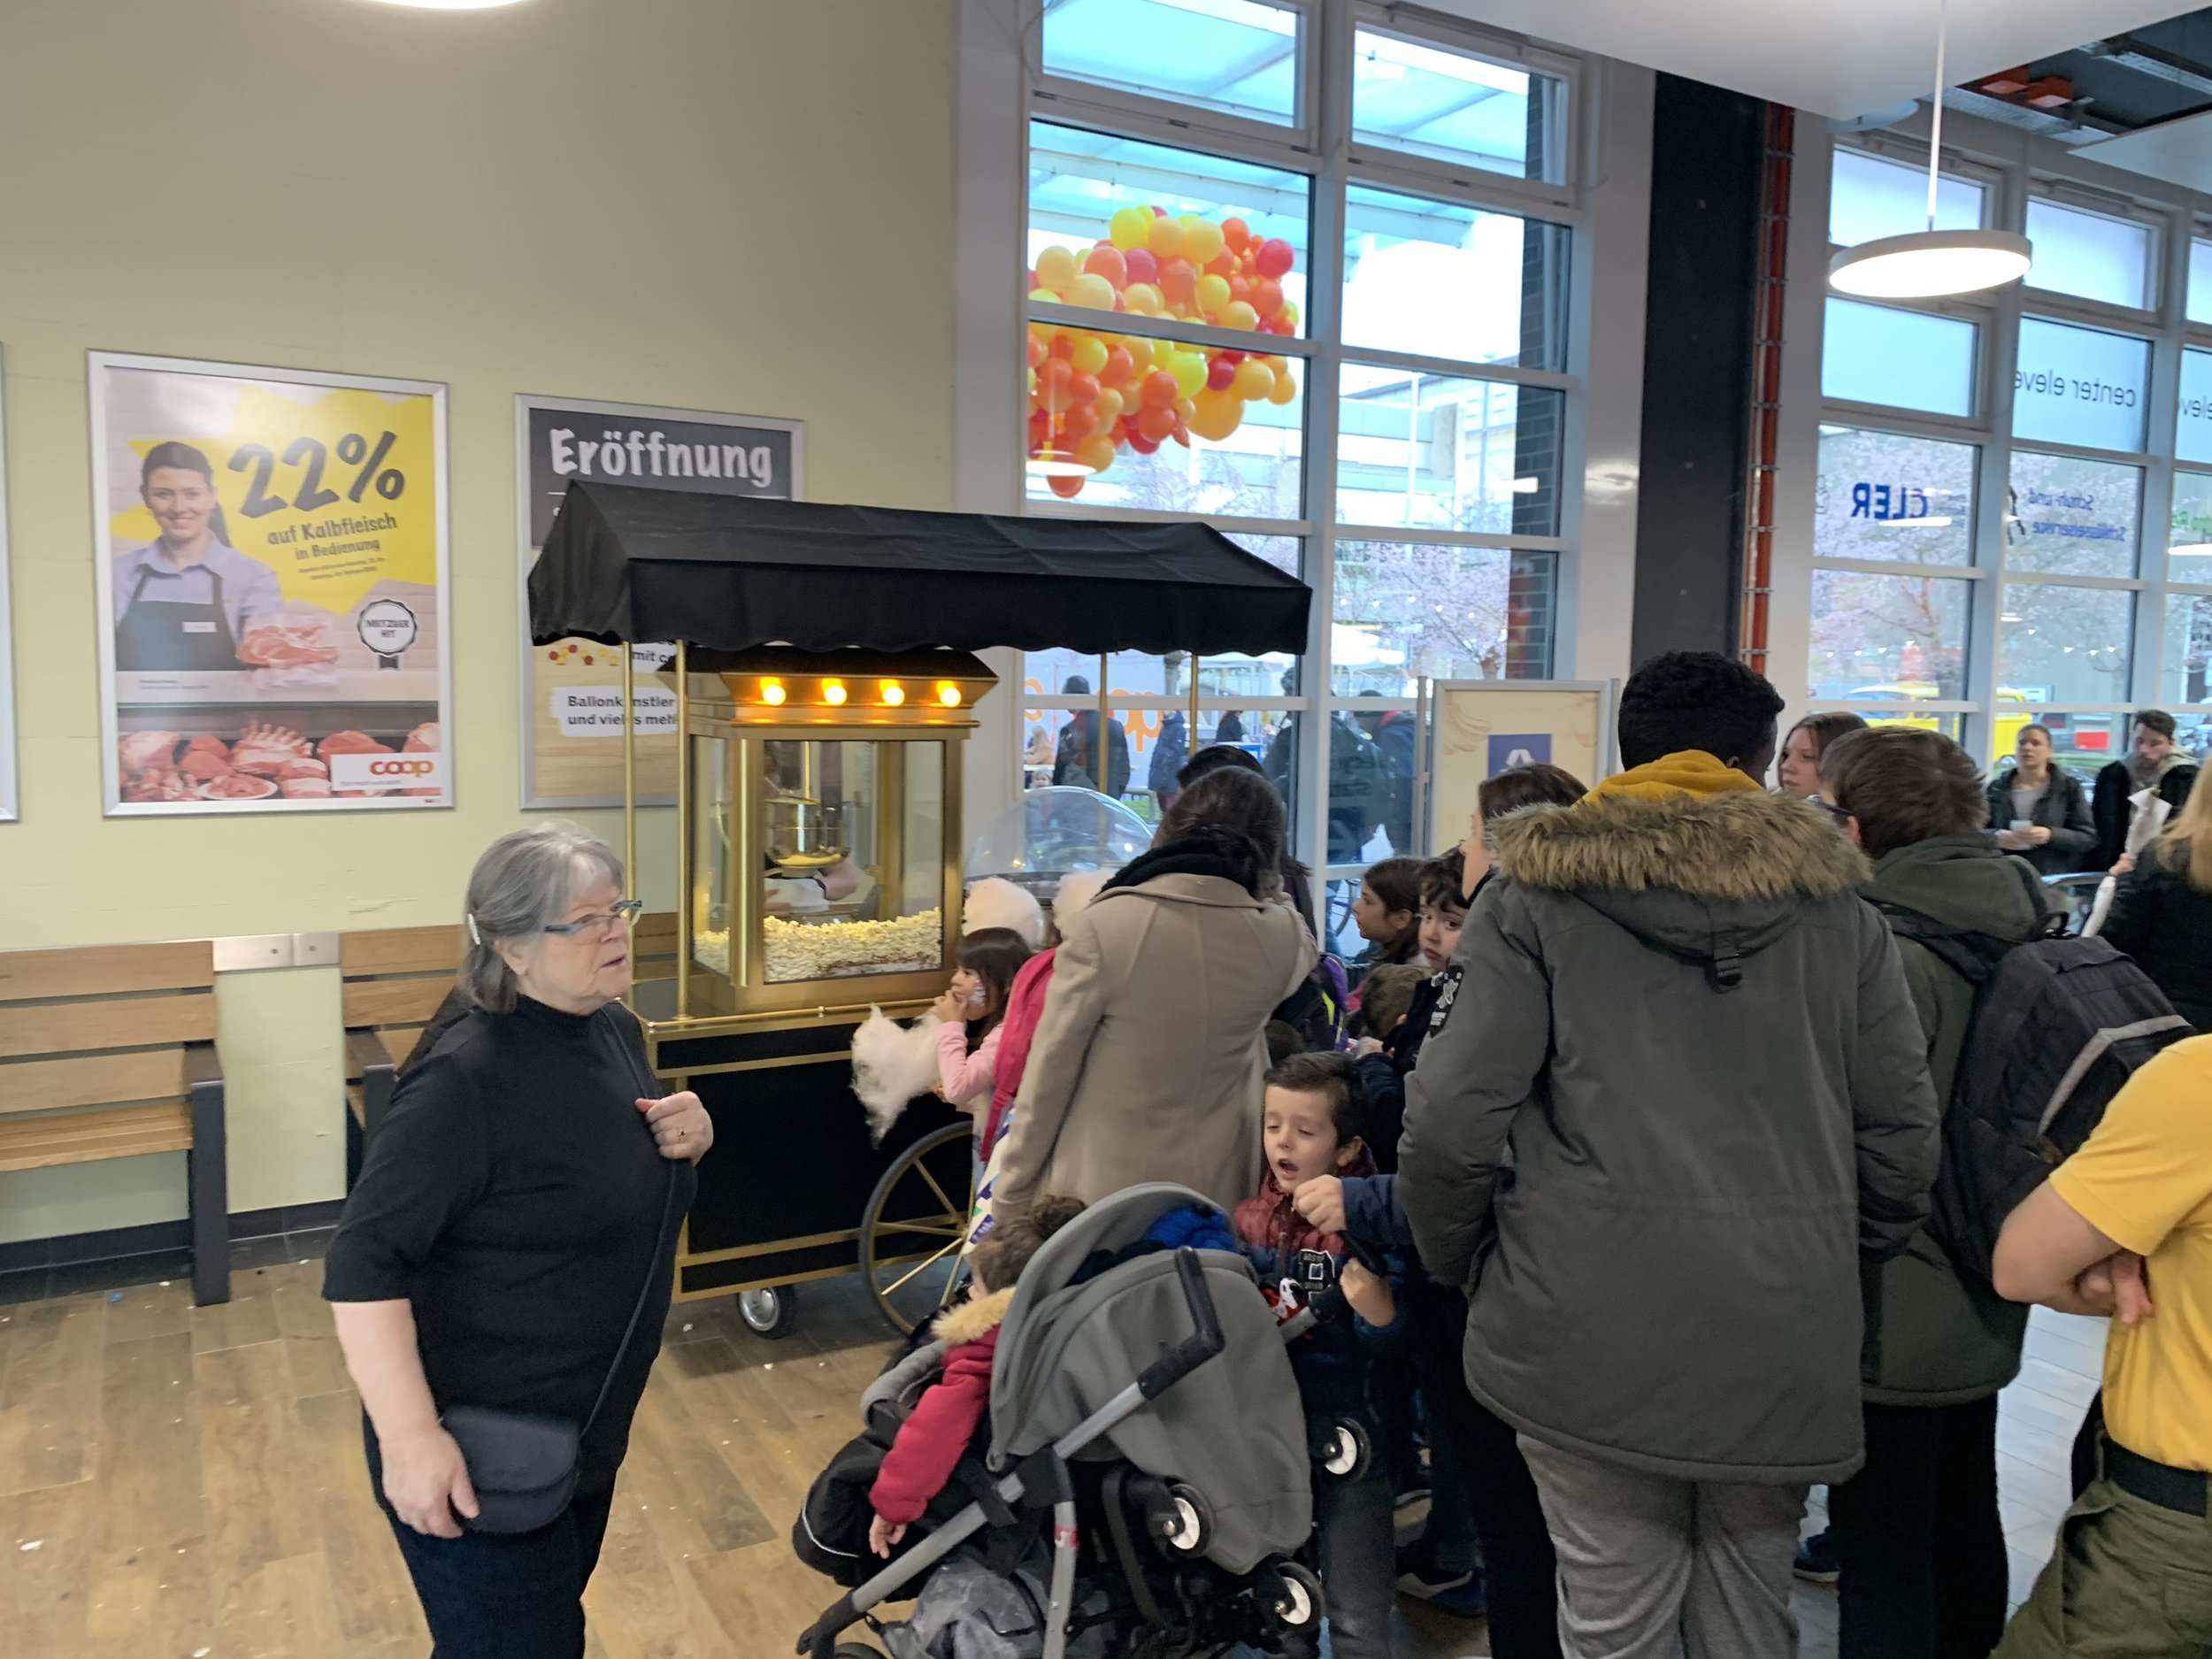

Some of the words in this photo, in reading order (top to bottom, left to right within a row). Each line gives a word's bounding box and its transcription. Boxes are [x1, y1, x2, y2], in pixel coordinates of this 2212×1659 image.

[549, 428, 772, 488] Eröffnung
[227, 430, 405, 518] 22%
[267, 524, 298, 545] auf
[301, 512, 397, 541] Kalbfleisch
[295, 547, 310, 560] in
[311, 540, 381, 558] Bedienung
[567, 695, 675, 708] Ballonknstler
[567, 714, 596, 726] und
[599, 714, 641, 726] viels
[645, 714, 676, 726] meh
[370, 759, 434, 778] coop
